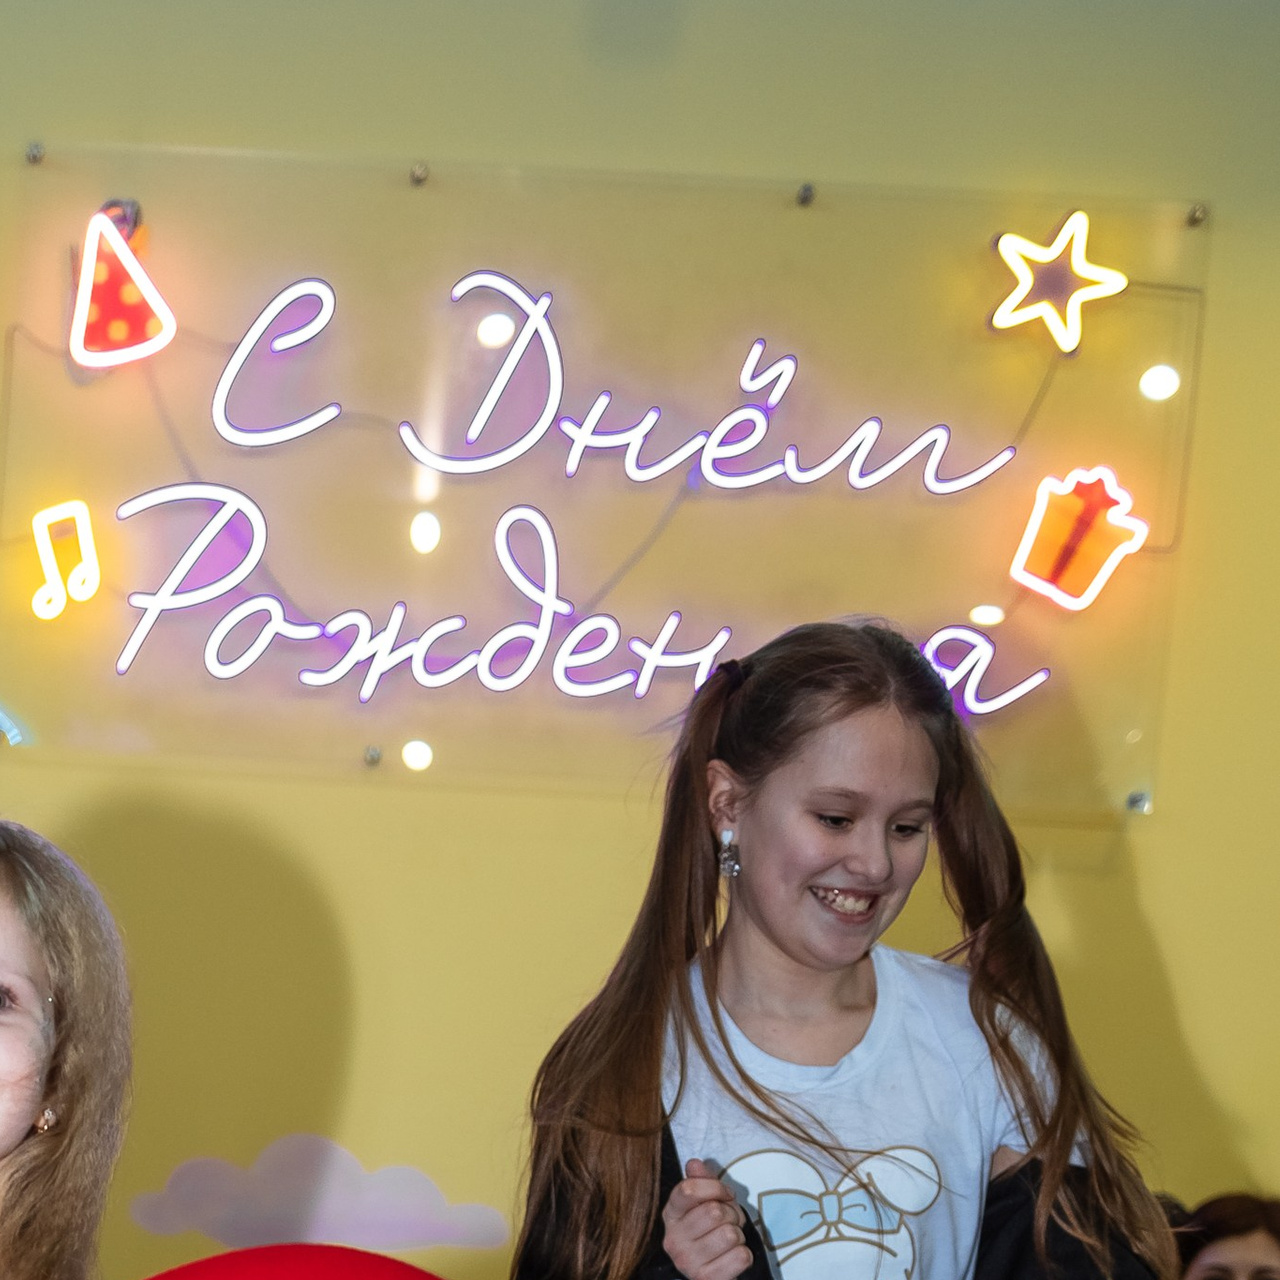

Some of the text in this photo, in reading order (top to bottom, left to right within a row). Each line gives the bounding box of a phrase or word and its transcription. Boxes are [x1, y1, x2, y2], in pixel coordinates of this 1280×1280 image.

[210, 271, 1016, 494] С Днём
[115, 480, 1052, 717] Рожденя
